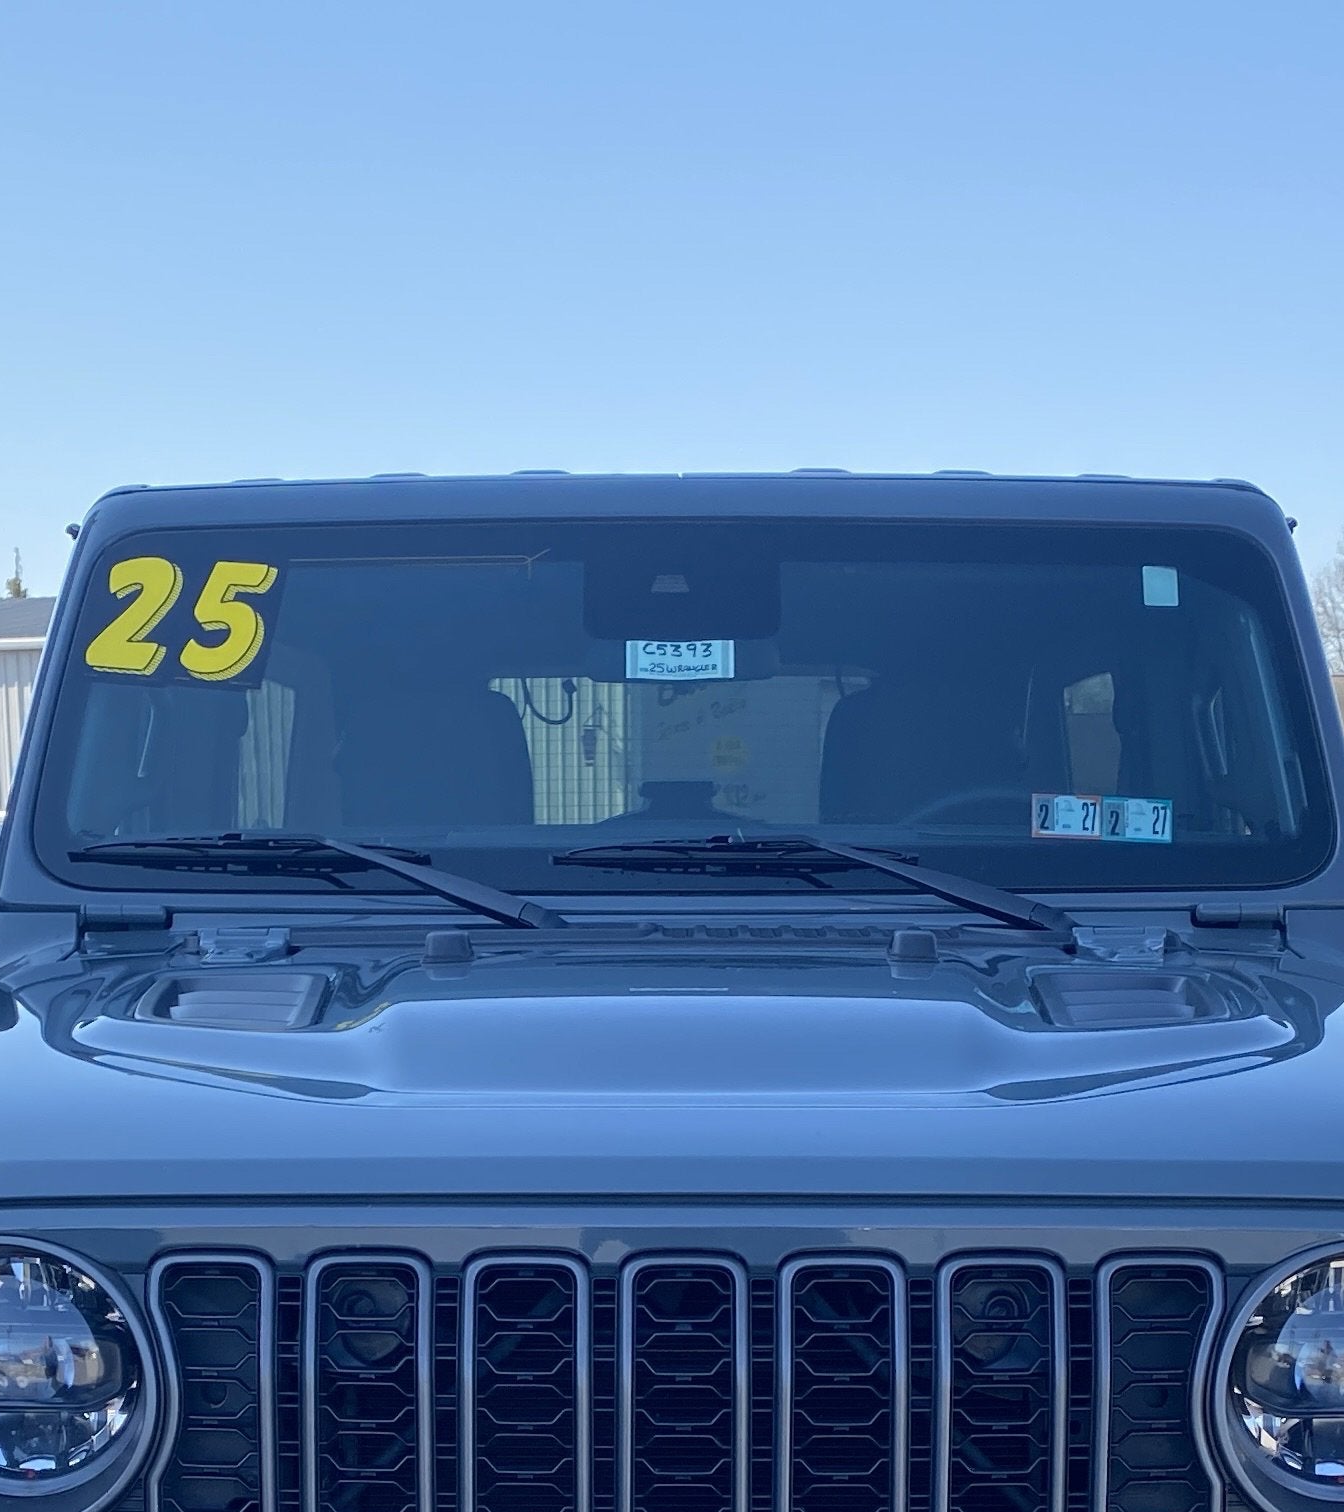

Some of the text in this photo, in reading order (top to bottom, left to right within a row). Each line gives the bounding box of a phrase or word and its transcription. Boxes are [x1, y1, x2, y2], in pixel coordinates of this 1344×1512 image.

[84, 555, 279, 681] 25
[642, 642, 713, 658] C5393
[1039, 803, 1050, 830] 2
[1081, 802, 1097, 832] 27
[1109, 810, 1120, 836] 2
[1152, 805, 1168, 836] 27
